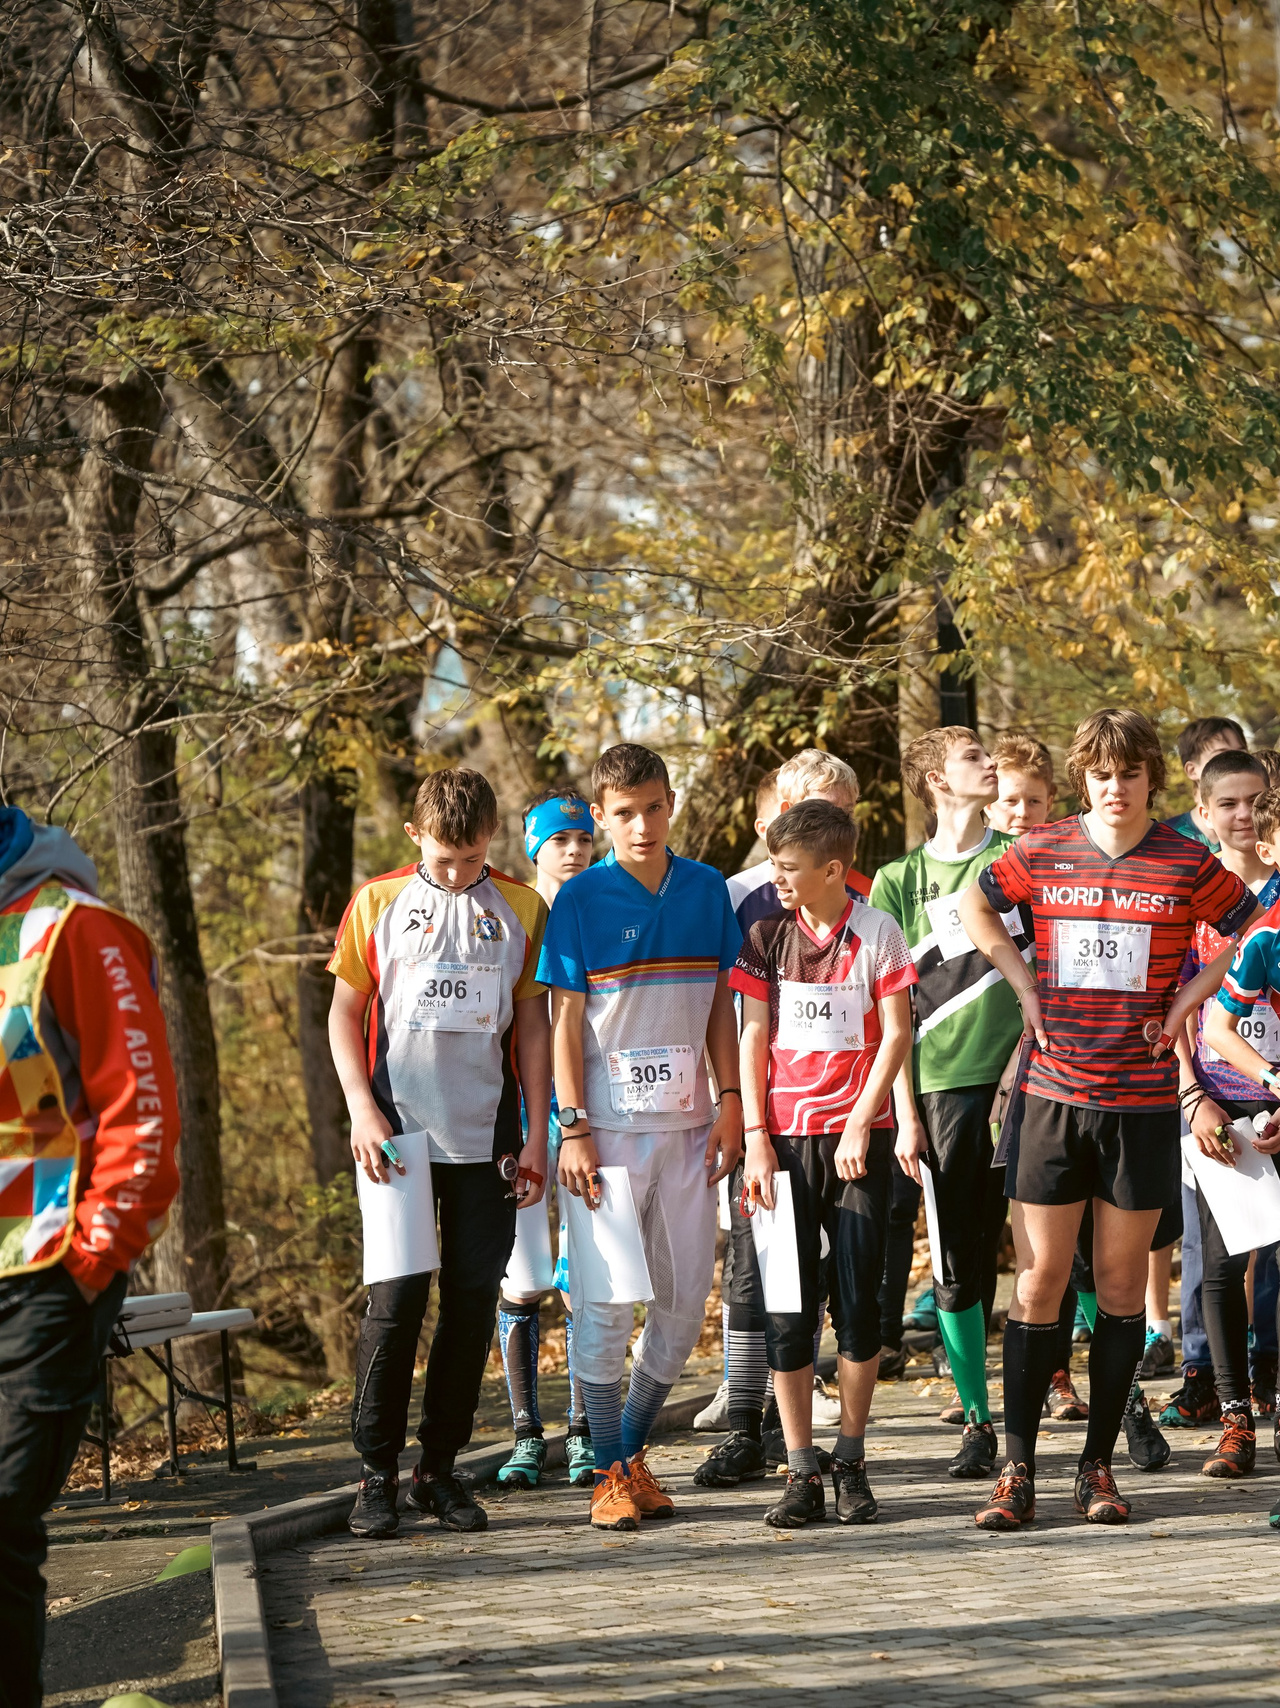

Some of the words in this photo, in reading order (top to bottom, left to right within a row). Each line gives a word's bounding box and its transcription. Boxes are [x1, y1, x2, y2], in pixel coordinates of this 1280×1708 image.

[1042, 885, 1104, 907] NORD
[1111, 889, 1180, 915] WEST
[1078, 938, 1118, 960] 303
[1127, 951, 1133, 963] 1
[100, 946, 141, 1013] KMV
[424, 979, 467, 999] 306
[476, 991, 481, 1003] 1
[417, 1000, 447, 1008] МЖ14
[794, 1000, 832, 1020] 304
[841, 1010, 847, 1022] 1
[1273, 1030, 1279, 1041] 1
[630, 1063, 672, 1084] 305
[679, 1072, 684, 1084] 1
[626, 1085, 654, 1094] МЖ14
